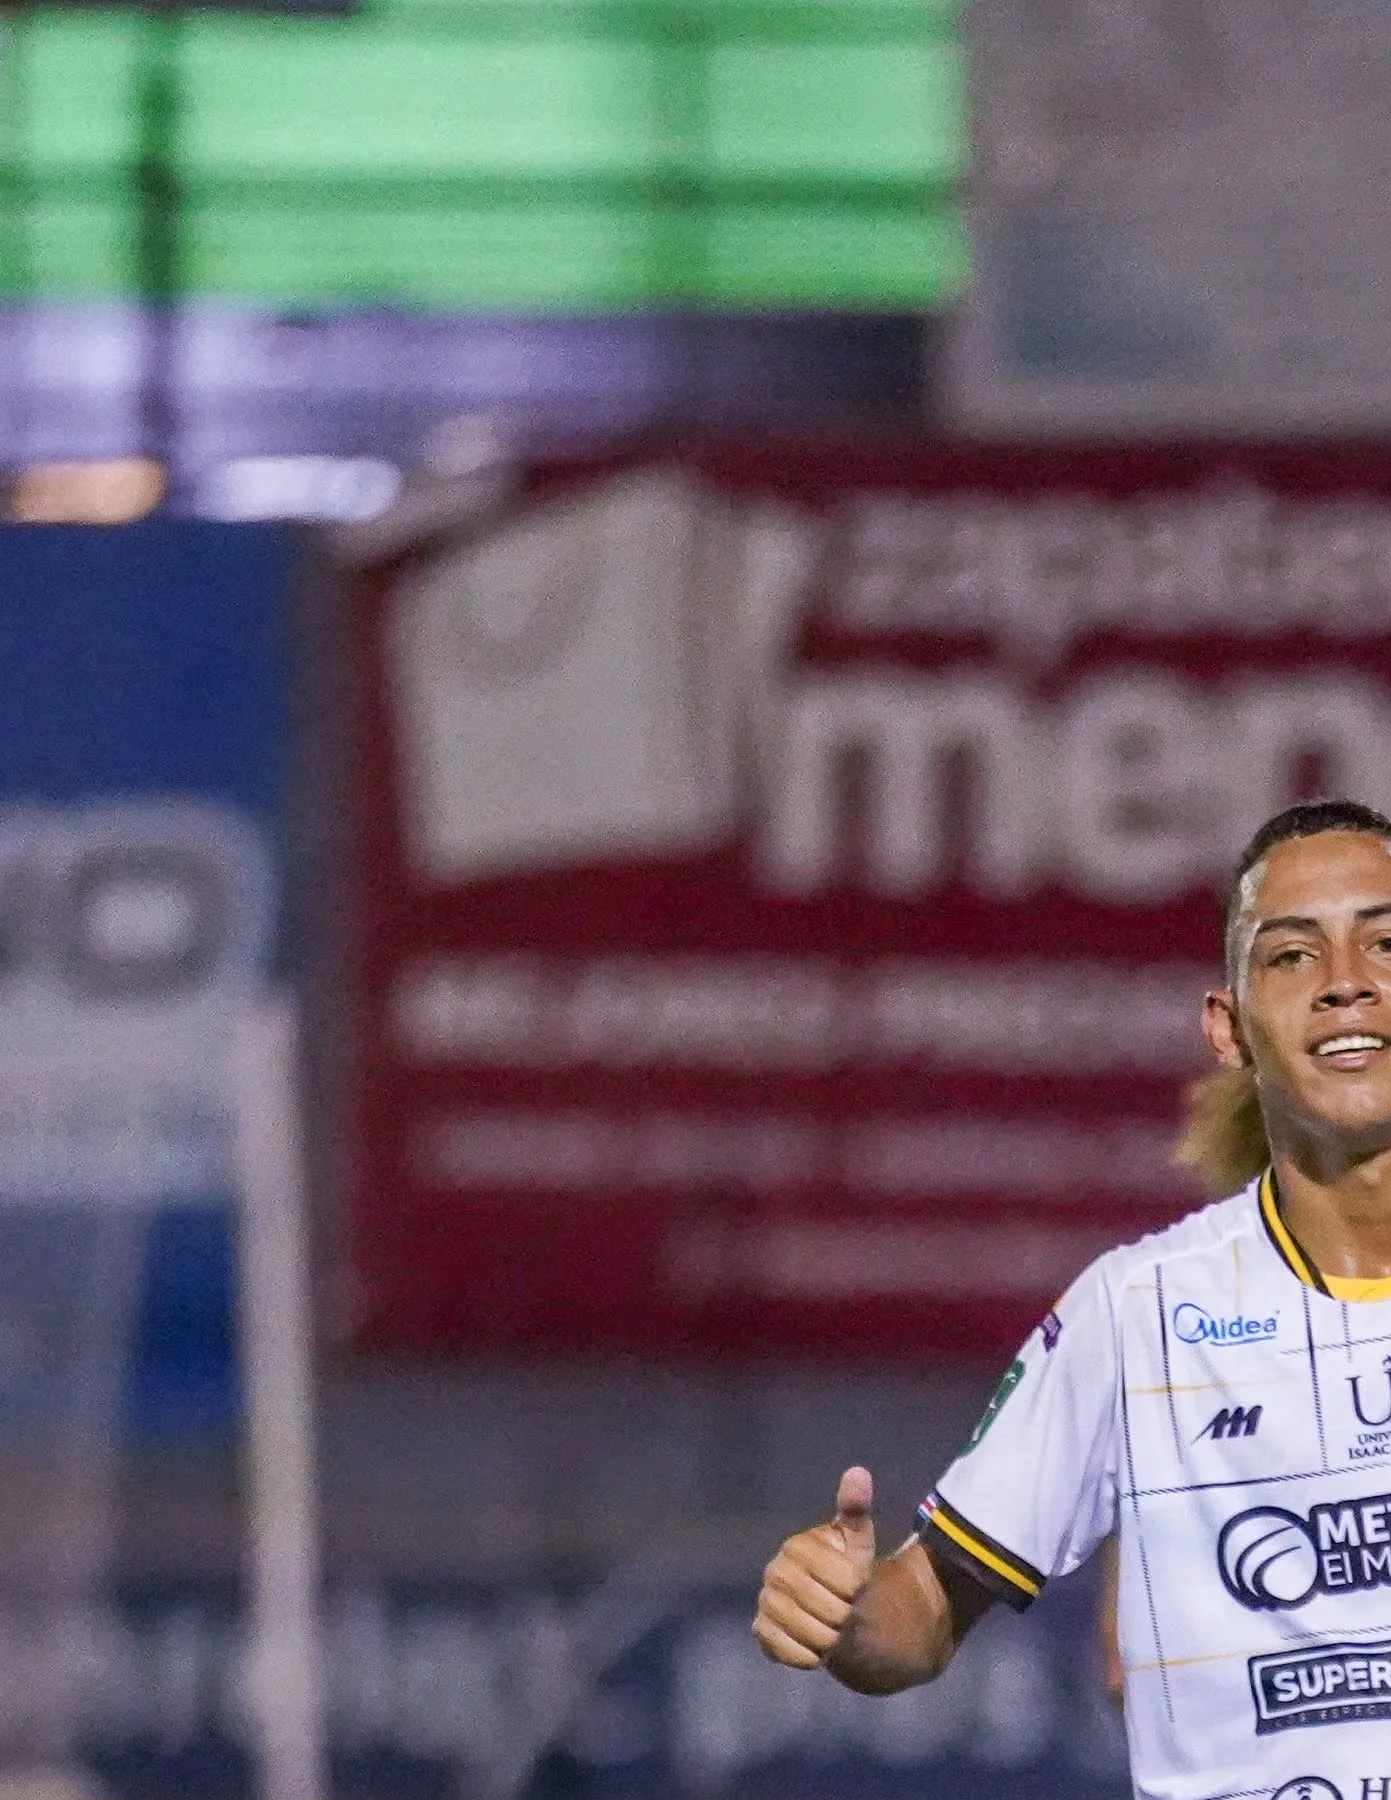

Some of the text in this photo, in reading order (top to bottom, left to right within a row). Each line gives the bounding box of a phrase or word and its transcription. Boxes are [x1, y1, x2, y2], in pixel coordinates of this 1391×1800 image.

[1180, 1308, 1277, 1343] Midea
[1348, 1443, 1391, 1460] ISAAC
[1323, 1550, 1353, 1587] El
